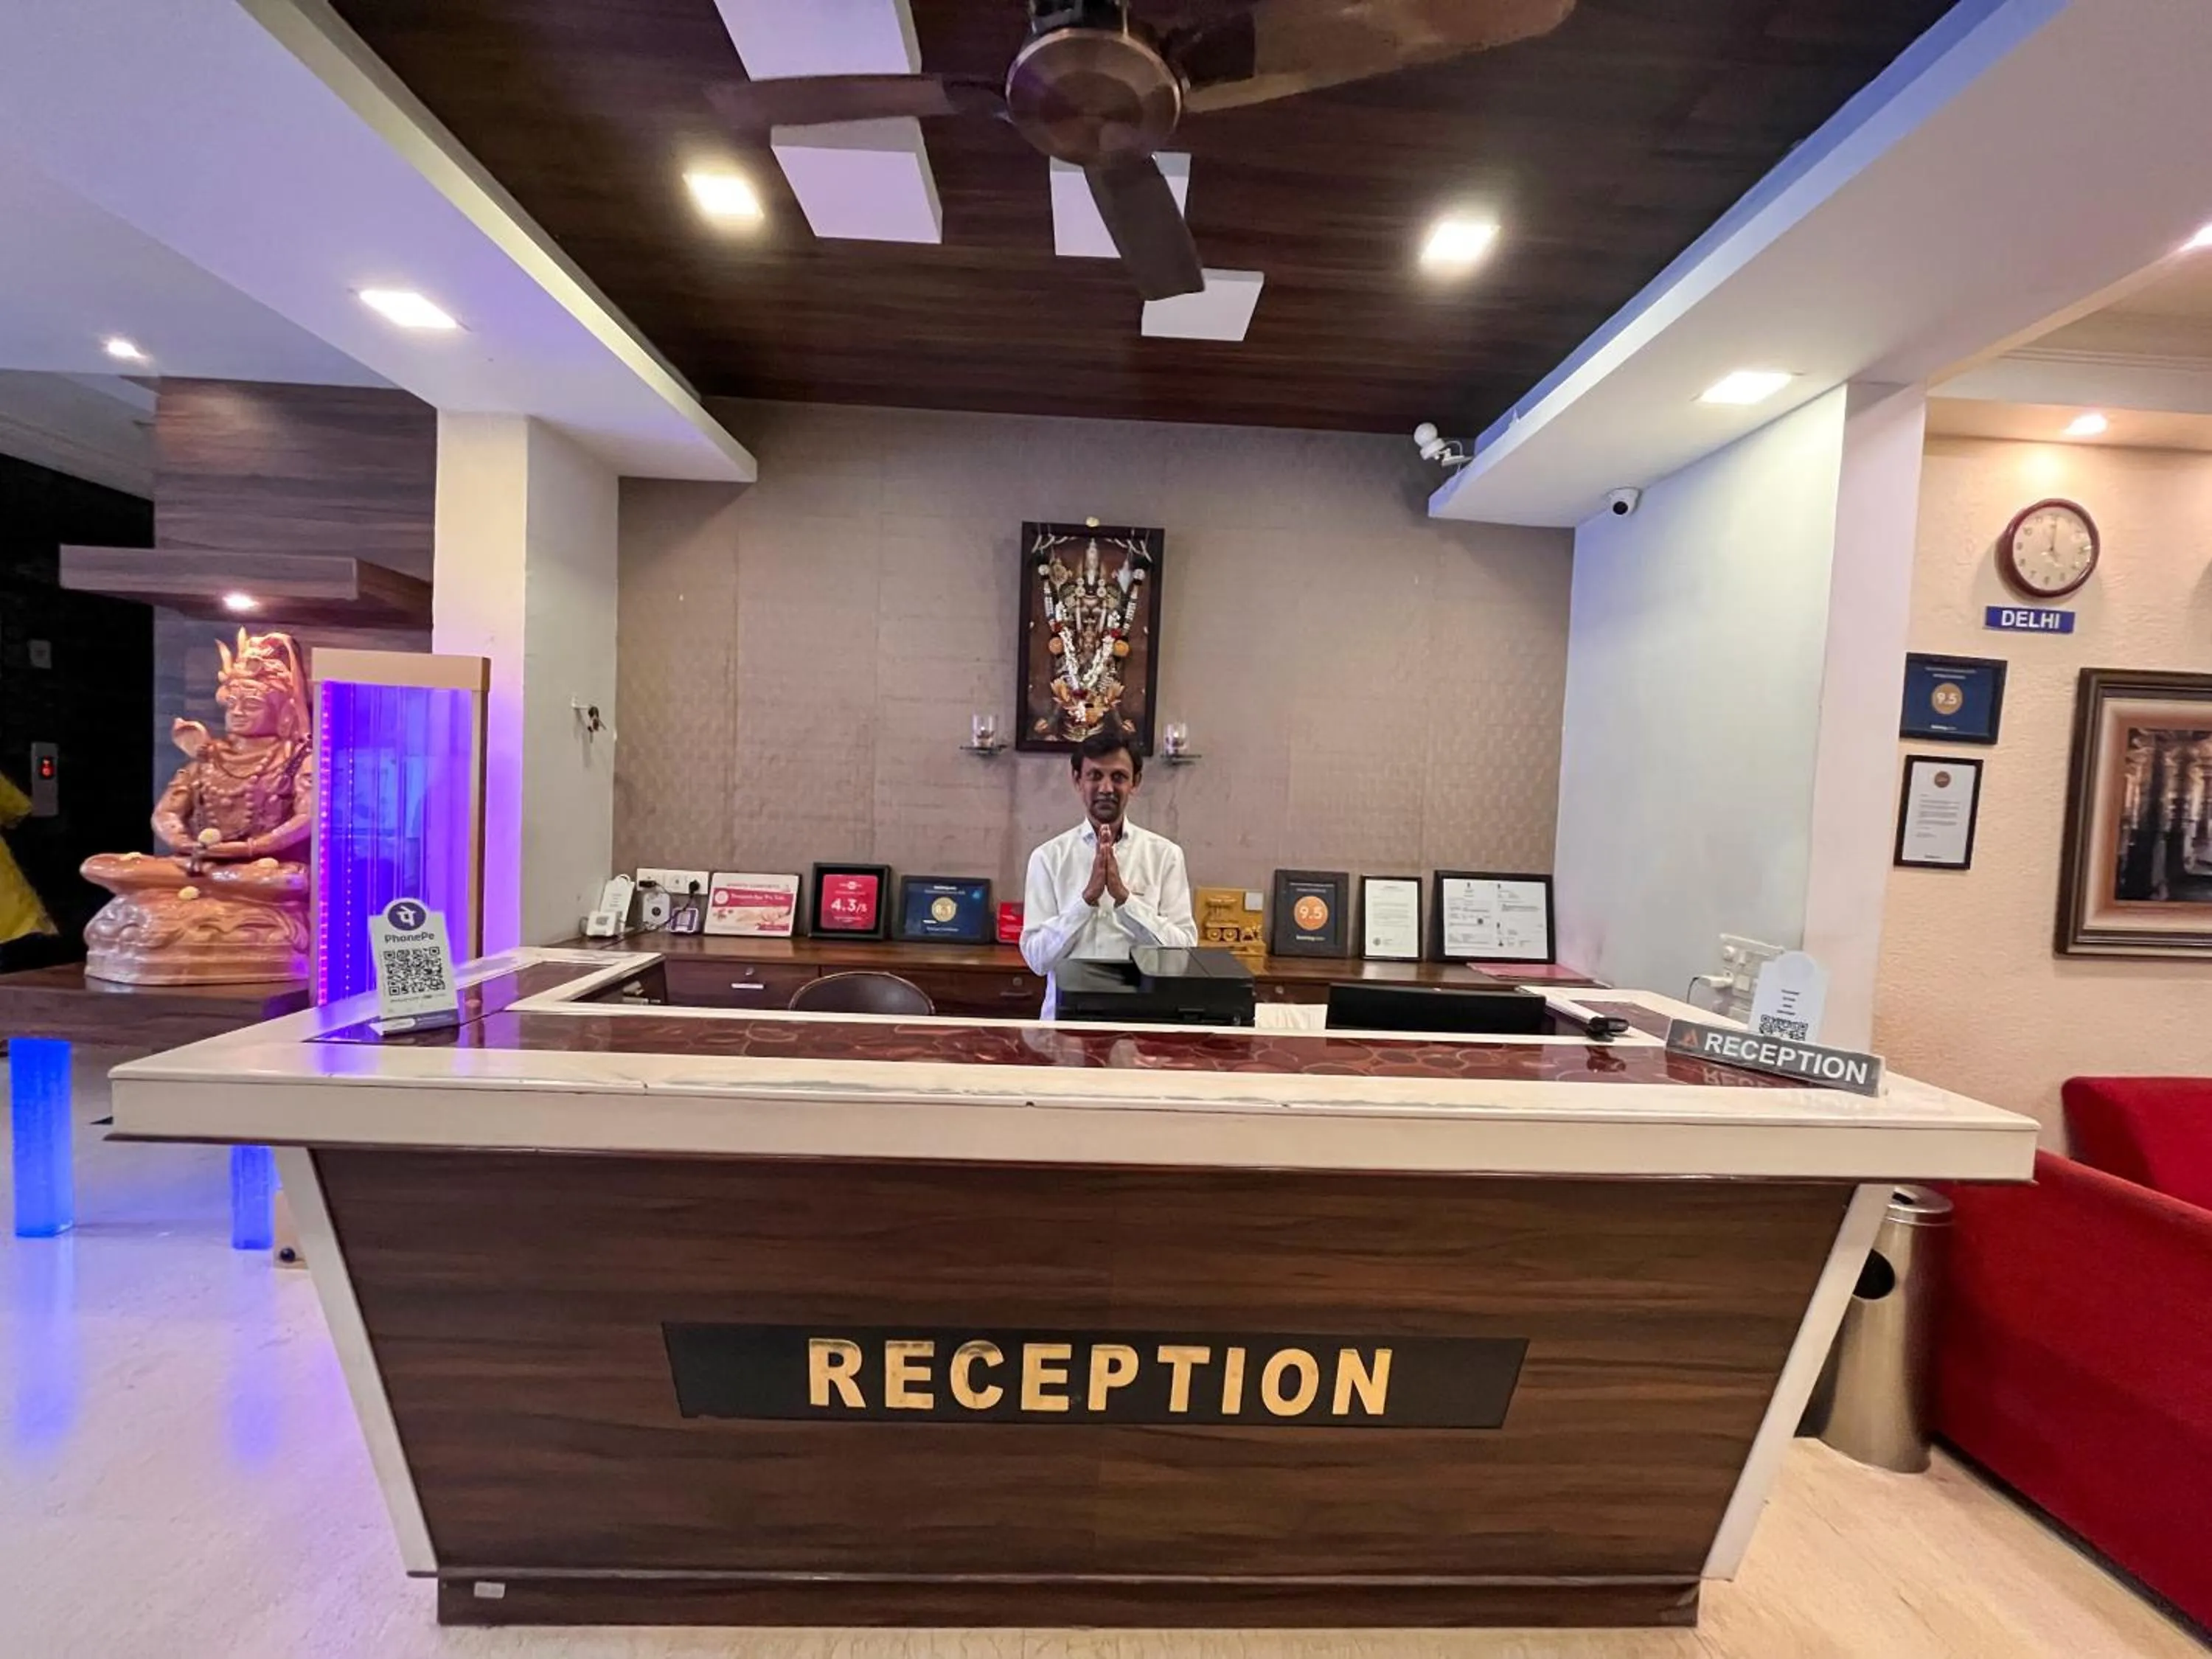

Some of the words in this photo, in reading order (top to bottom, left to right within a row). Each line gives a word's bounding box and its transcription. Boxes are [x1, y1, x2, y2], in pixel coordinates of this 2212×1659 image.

[2001, 610, 2061, 630] DELHI
[1299, 905, 1324, 920] 9.5
[384, 932, 435, 944] PhonePe
[1704, 1032, 1868, 1085] RECEPTION
[808, 1338, 1394, 1417] RECEPTION
